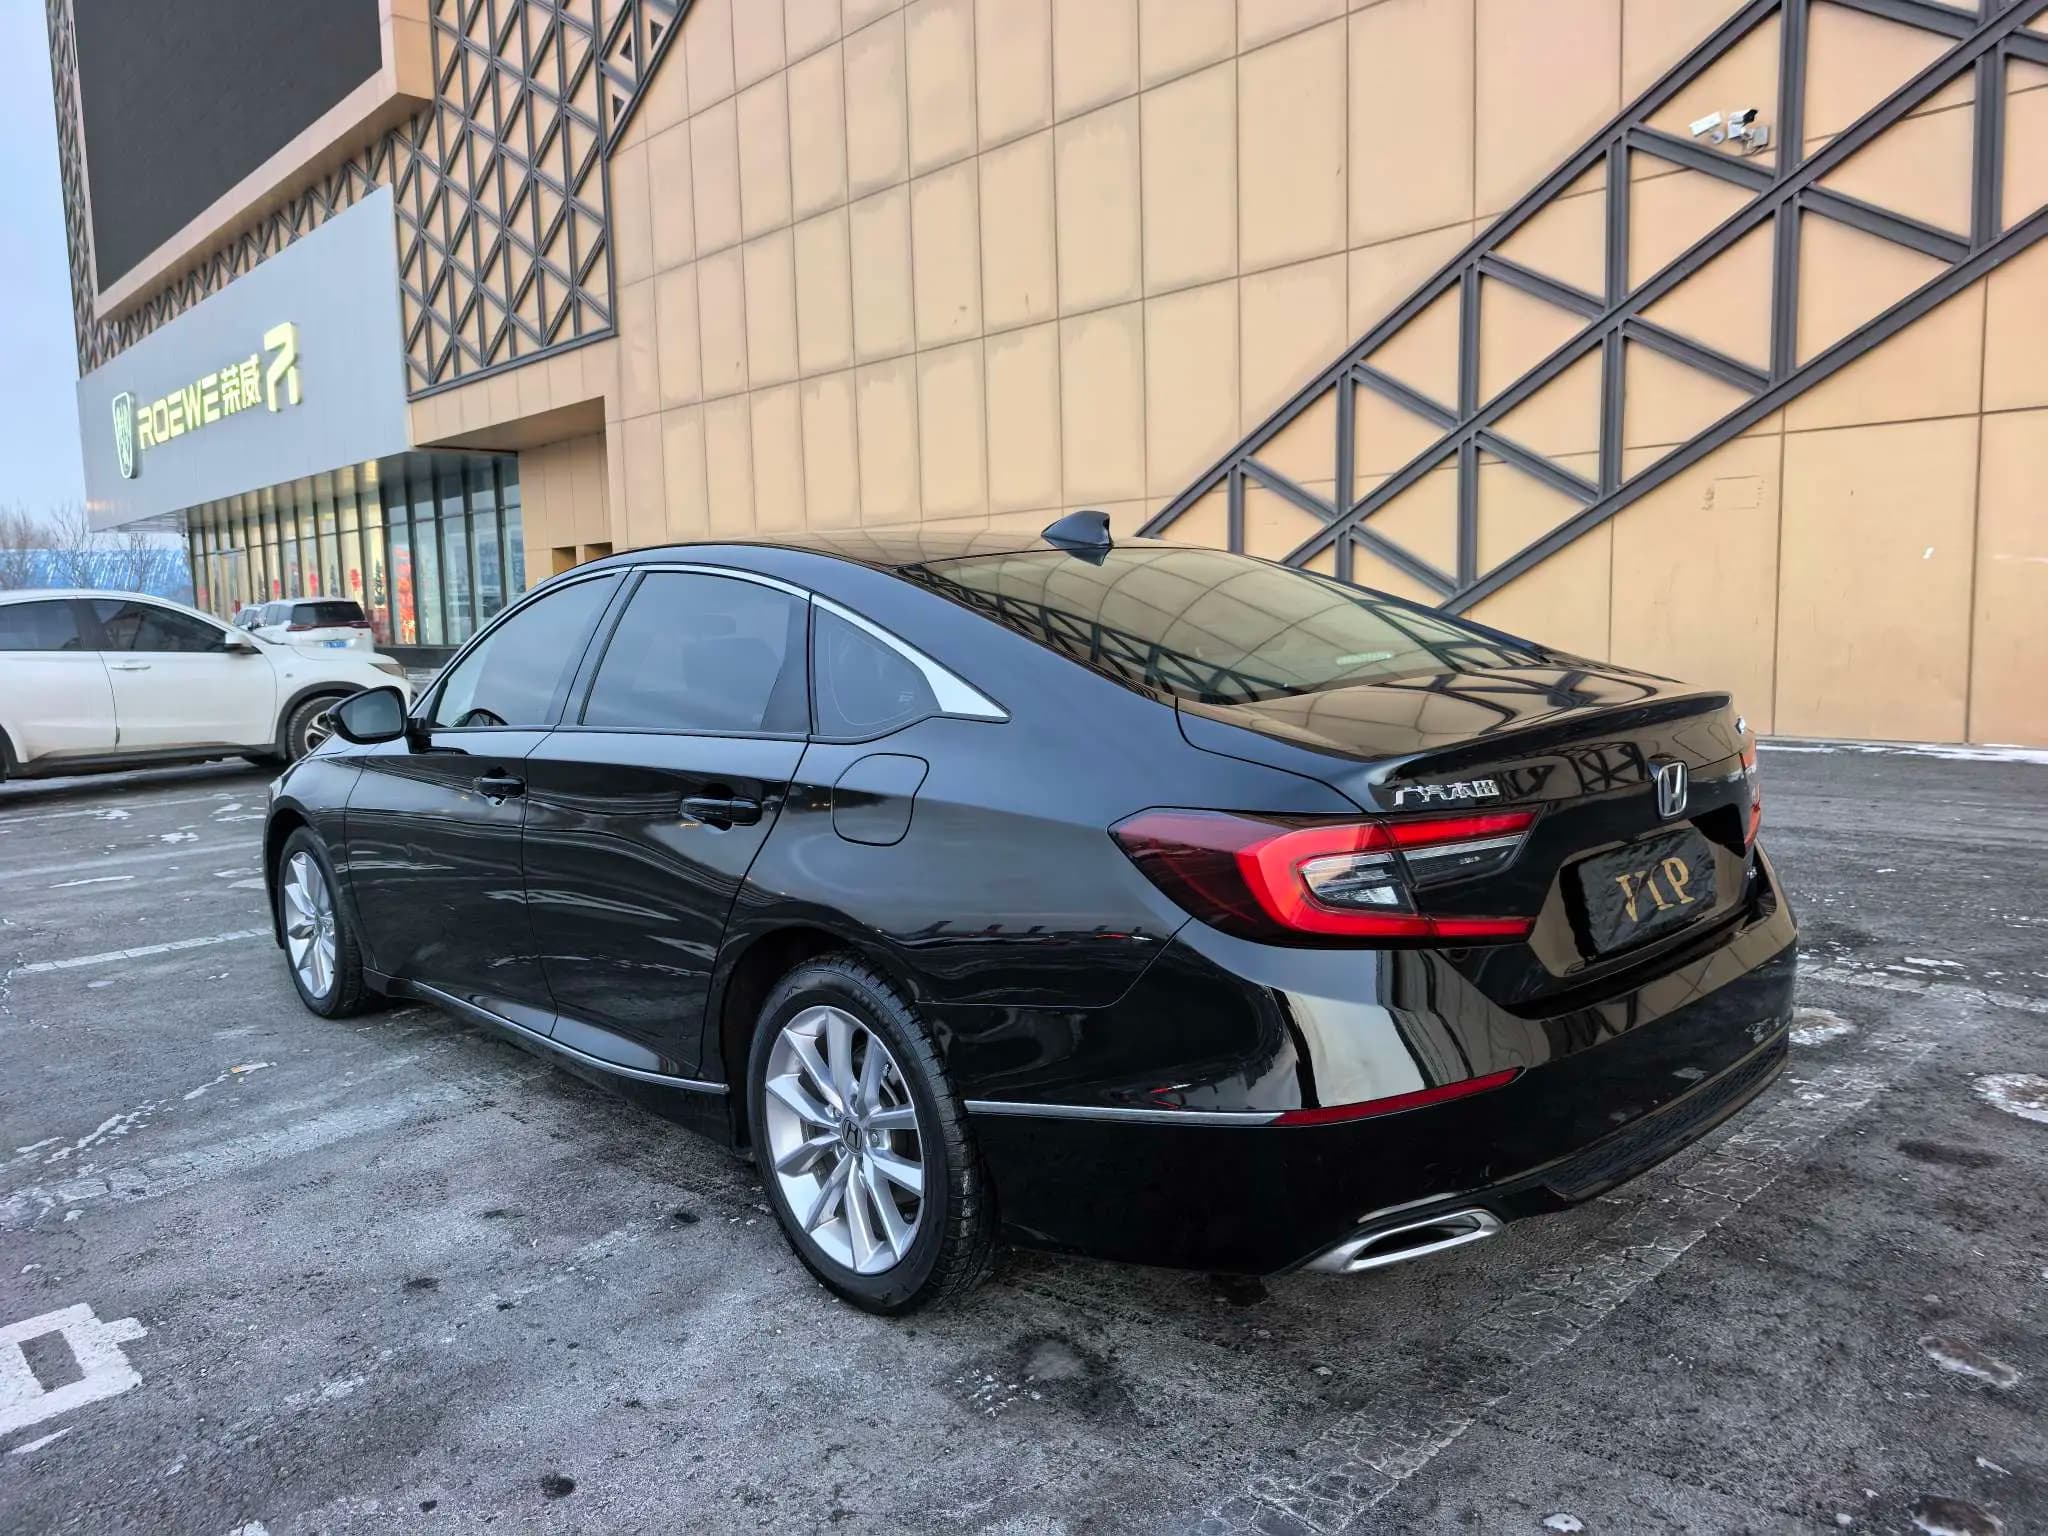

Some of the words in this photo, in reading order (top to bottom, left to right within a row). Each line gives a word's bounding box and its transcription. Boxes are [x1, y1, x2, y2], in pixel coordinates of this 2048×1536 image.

[137, 372, 221, 450] ROEWE
[220, 353, 262, 416] 荣威
[1393, 779, 1500, 807] 广汽本田
[1615, 857, 1695, 922] VIP
